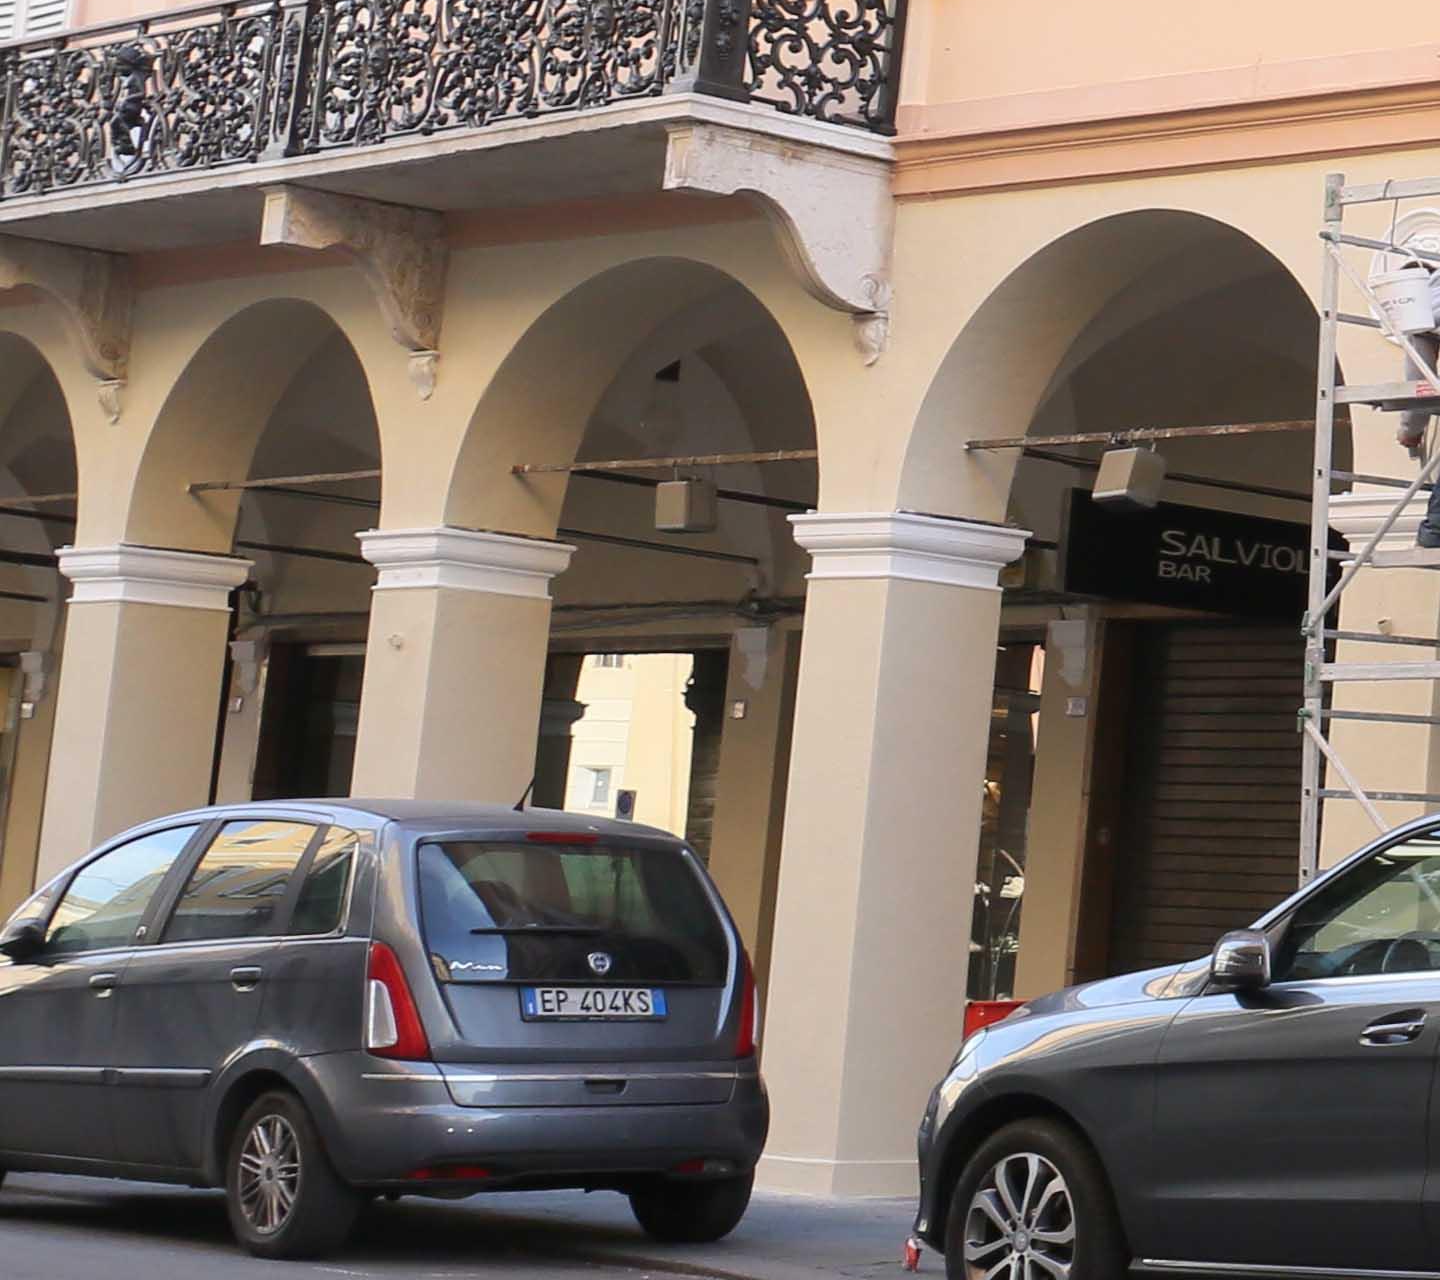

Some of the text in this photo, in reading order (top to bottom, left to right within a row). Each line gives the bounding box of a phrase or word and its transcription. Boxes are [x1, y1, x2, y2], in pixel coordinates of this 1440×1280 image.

[1158, 560, 1212, 584] BAR
[540, 989, 651, 1013] EP 404KS
